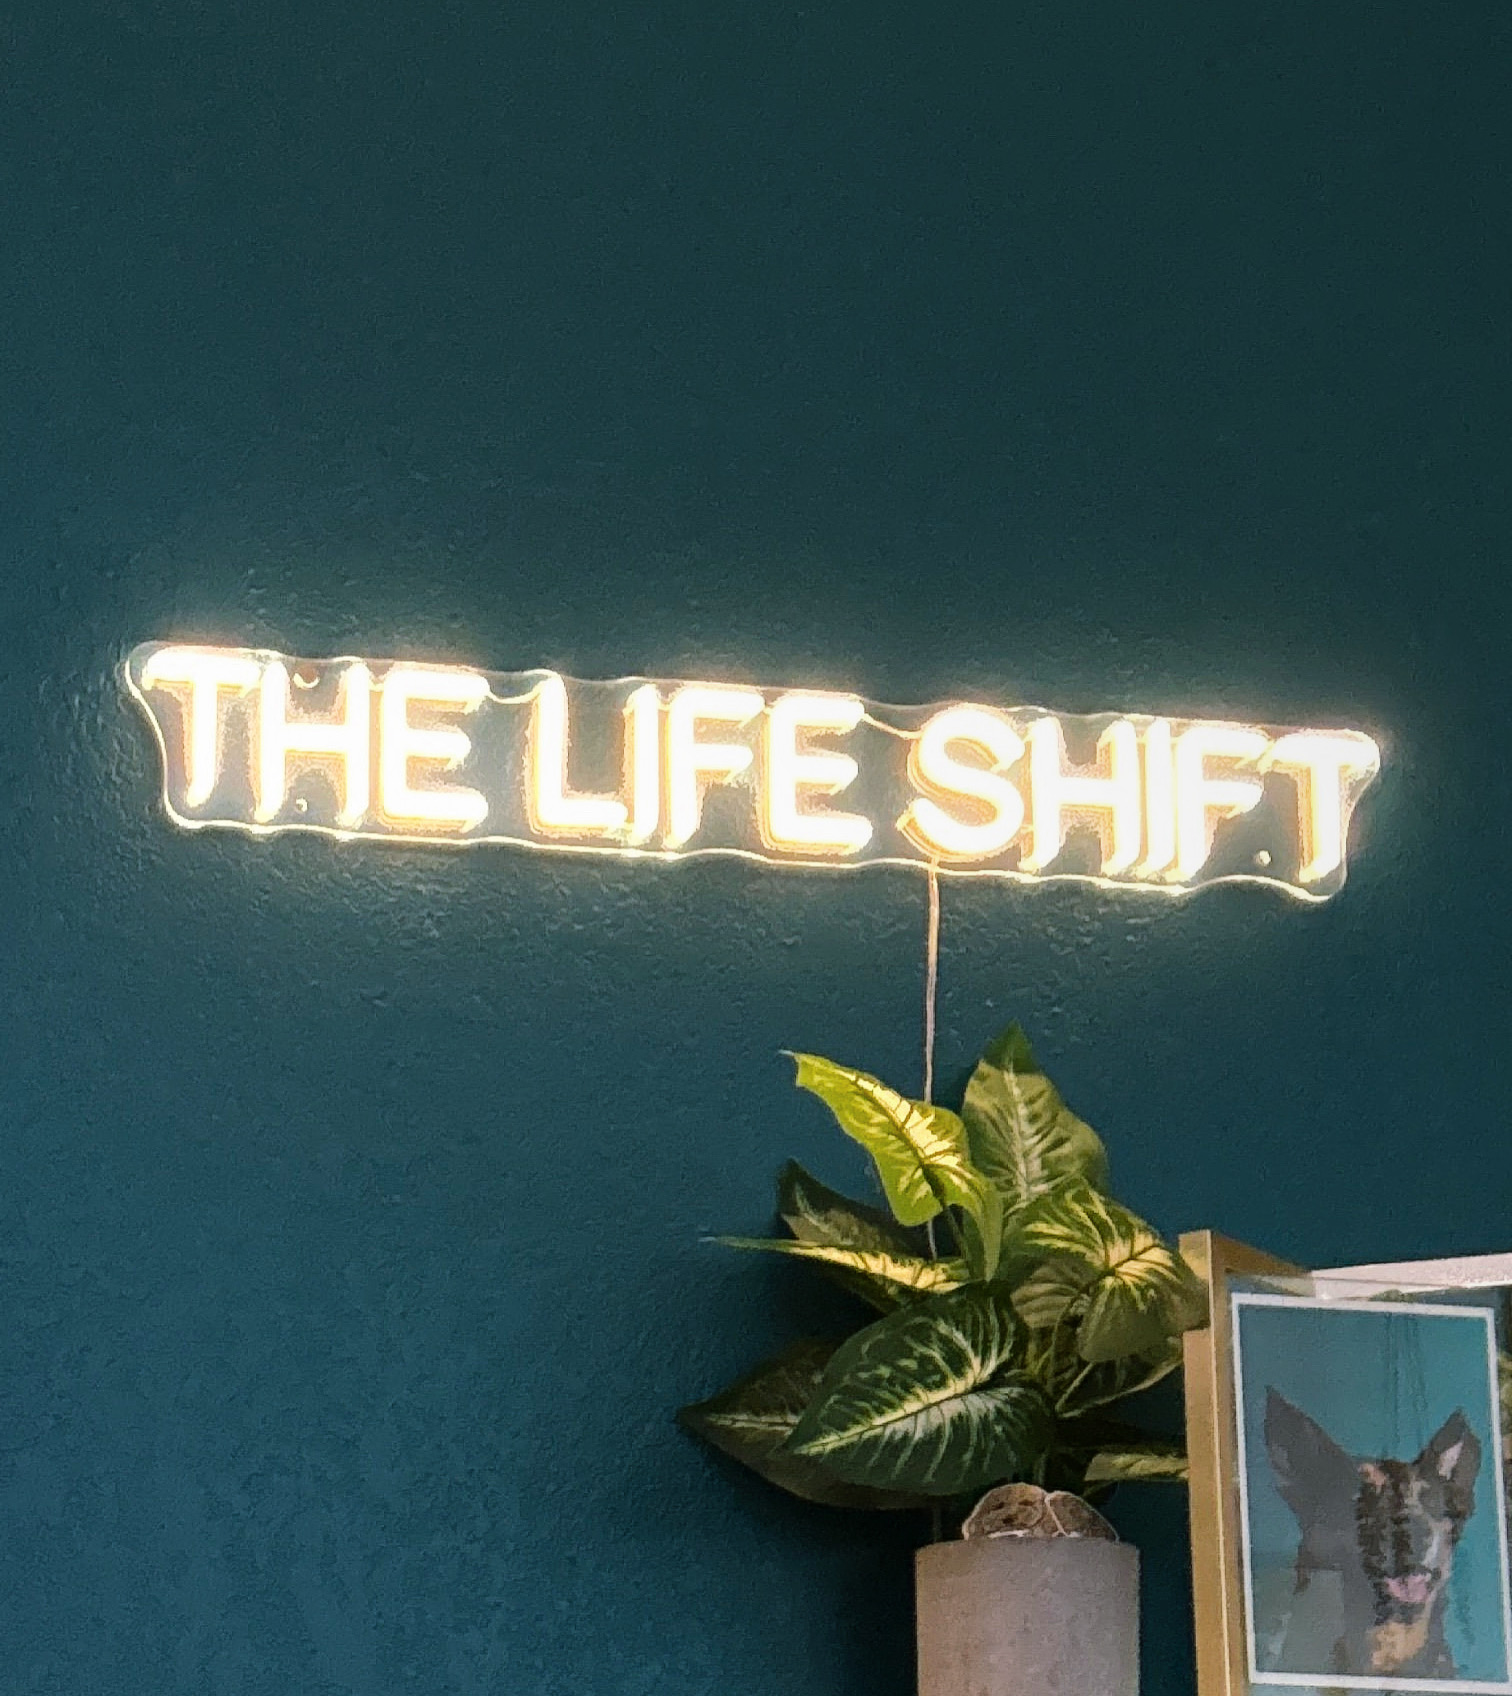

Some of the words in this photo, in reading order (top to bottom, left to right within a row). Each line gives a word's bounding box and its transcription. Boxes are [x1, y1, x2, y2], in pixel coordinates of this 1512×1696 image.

[142, 647, 490, 833] THE
[526, 674, 874, 855] LIFE
[898, 703, 1380, 884] SHIFT
